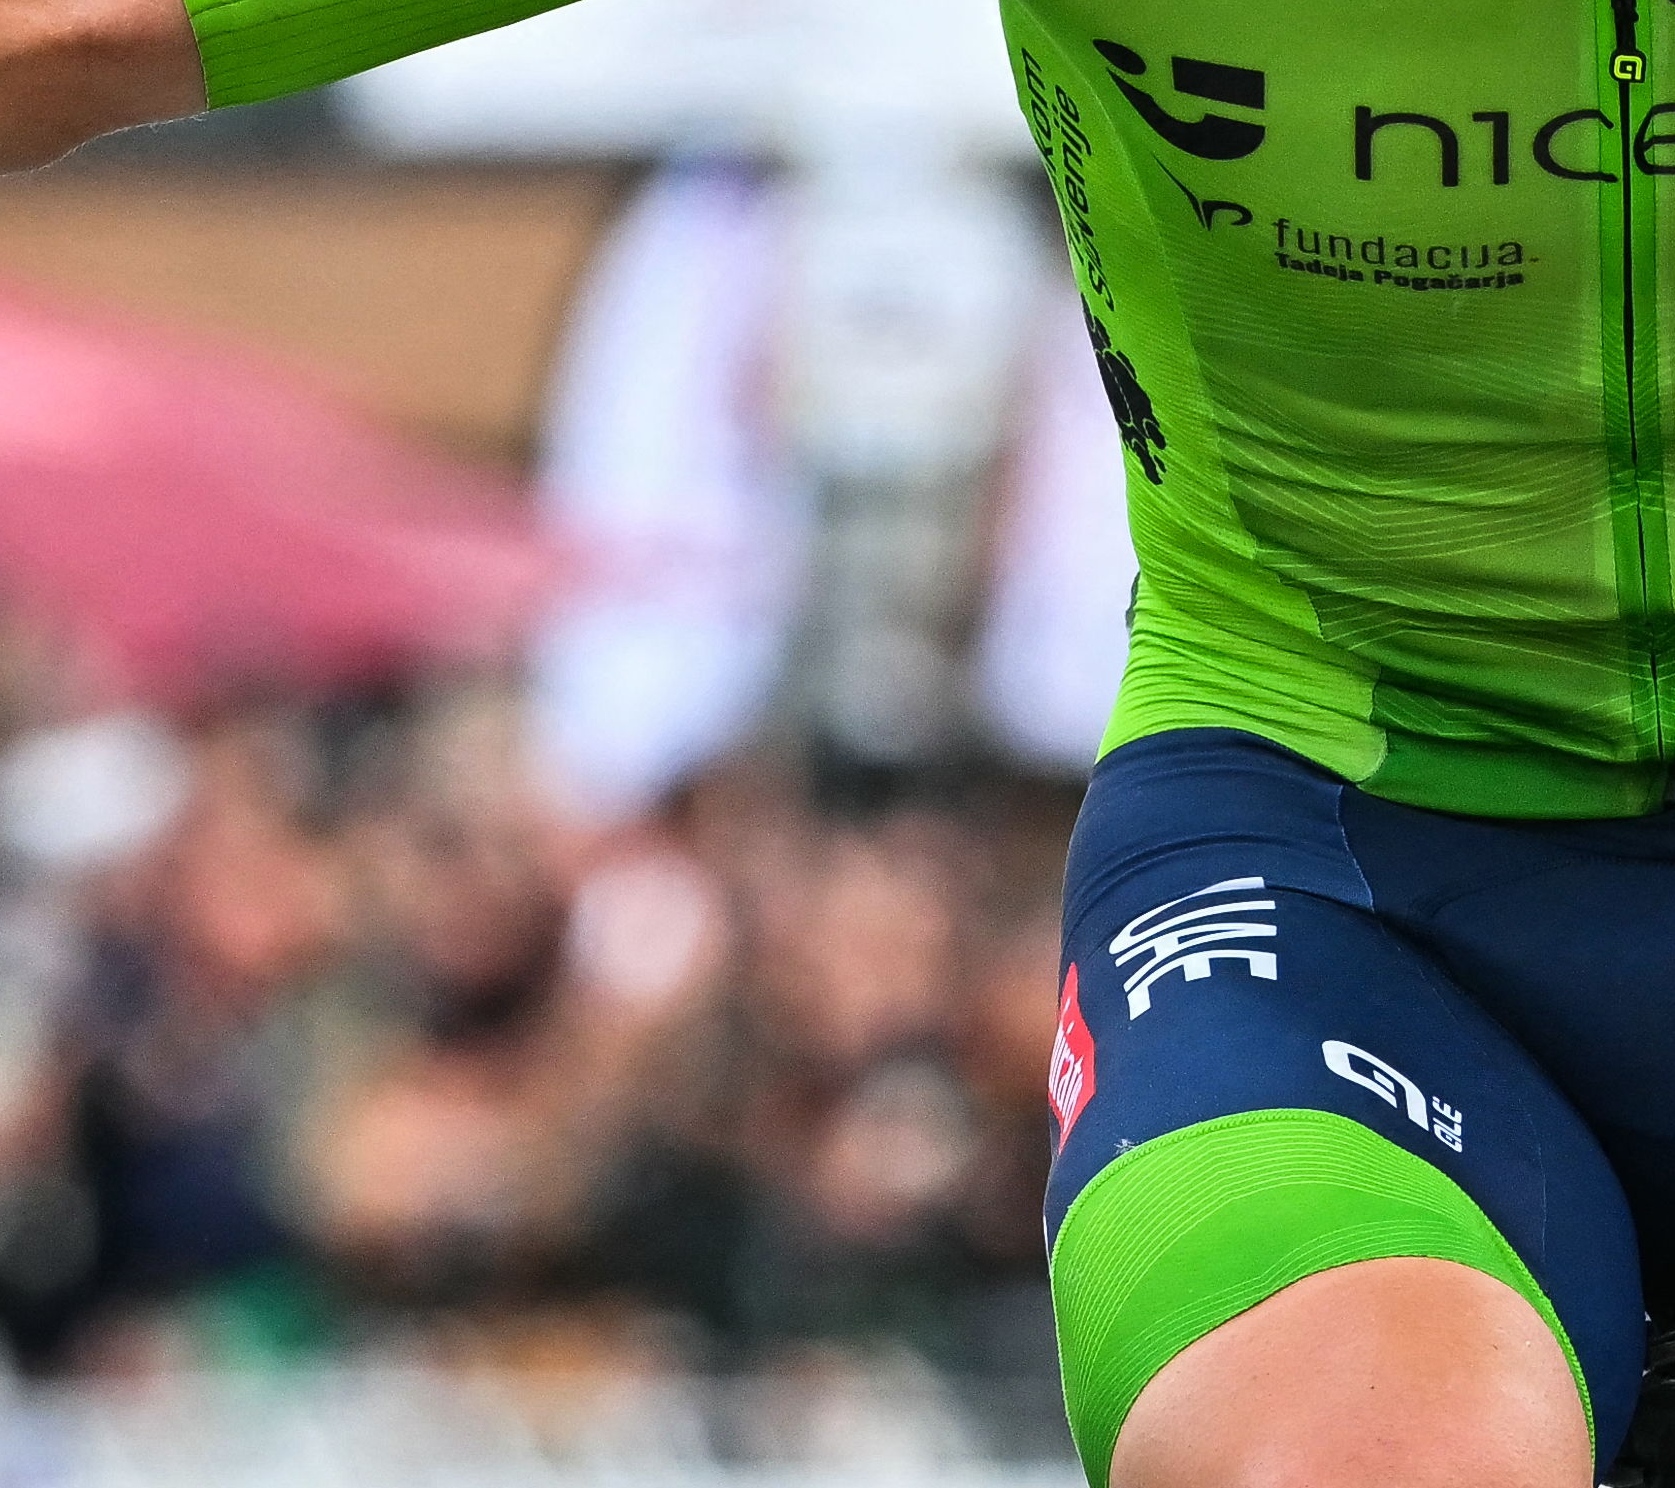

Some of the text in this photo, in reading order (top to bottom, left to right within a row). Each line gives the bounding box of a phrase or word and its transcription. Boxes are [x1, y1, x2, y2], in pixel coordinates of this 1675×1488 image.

[1272, 217, 1523, 270] fundacija
[1275, 252, 1524, 291] Tadeja Pogačarja
[1109, 876, 1278, 1021] UAE
